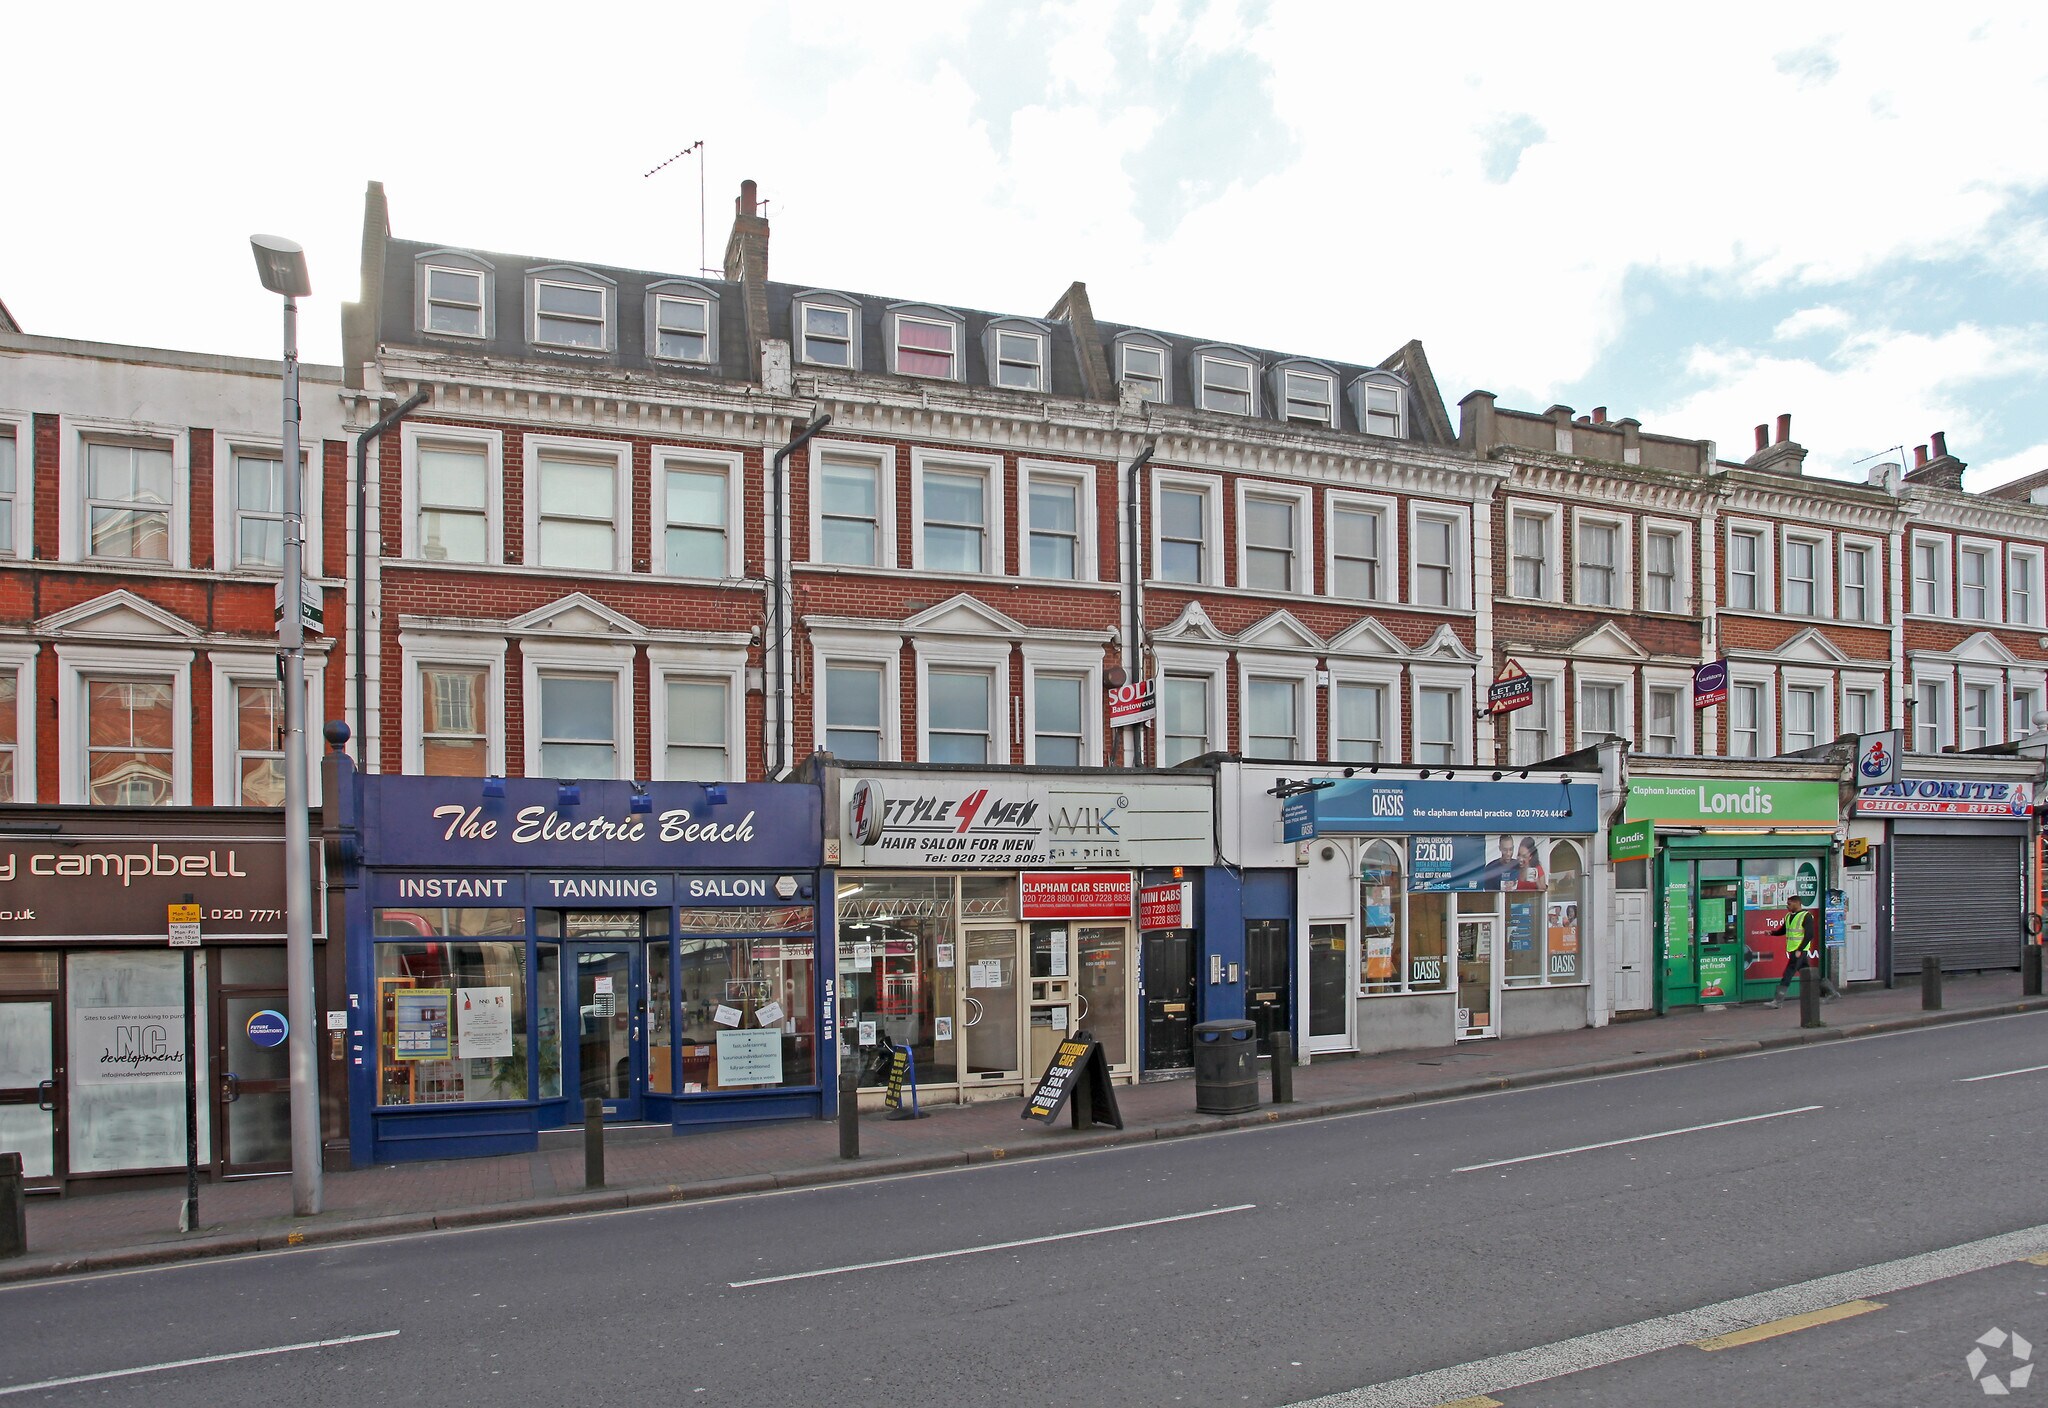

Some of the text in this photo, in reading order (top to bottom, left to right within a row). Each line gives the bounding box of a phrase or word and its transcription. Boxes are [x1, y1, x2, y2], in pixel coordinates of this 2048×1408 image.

[1108, 679, 1156, 706] SOLD
[1491, 686, 1510, 696] LET
[1515, 681, 1529, 690] BY
[1632, 785, 1696, 797] Clapham Junction
[1372, 794, 1404, 816] OASIS
[1698, 785, 1773, 814] Londis
[883, 789, 1040, 834] STYLE 4 MEN
[1412, 808, 1426, 817] the
[1427, 808, 1458, 818] clapham
[1459, 808, 1483, 817] dental
[1484, 809, 1513, 819] practice
[1516, 809, 1530, 818] 020
[1531, 809, 1549, 818] 7924
[1863, 800, 2008, 814] CHICKEN & RIBS
[433, 804, 756, 843] The Electric Beach
[1301, 824, 1313, 836] OASIS
[881, 837, 1034, 851] HAIR SALON FOR MEN
[1616, 832, 1644, 845] Londis
[924, 853, 1046, 863] Tel: 020 7223 8085
[1083, 846, 1120, 859] print
[1415, 843, 1453, 861] £26.00
[30, 843, 247, 887] campbell
[399, 879, 508, 898] INSTANT
[549, 879, 658, 898] TANNING
[689, 879, 766, 898] SALON
[1022, 882, 1131, 893] CLAPHAM CAR SERVICE
[1022, 893, 1130, 903] 020 7228 8800 020 7228 8836
[1141, 888, 1181, 904] MINI CABS
[1141, 902, 1180, 915] 020 7228 8800
[211, 909, 243, 920] 020
[249, 909, 281, 922] 7771
[1141, 914, 1181, 926] 020 7228 8836
[1765, 918, 1779, 929] Top
[1413, 960, 1440, 980] OASIS
[1551, 954, 1576, 973] OASIS
[116, 1024, 167, 1060] NC
[1058, 1042, 1089, 1056] INTERNET
[100, 1047, 185, 1070] developments
[1058, 1054, 1077, 1067] CAFE
[101, 1070, 183, 1079] info@ncdevelopments.com
[1049, 1066, 1074, 1078] COPY
[1047, 1077, 1065, 1088] FAX
[1038, 1086, 1063, 1098] SCAN
[1032, 1095, 1059, 1108] PRINT
